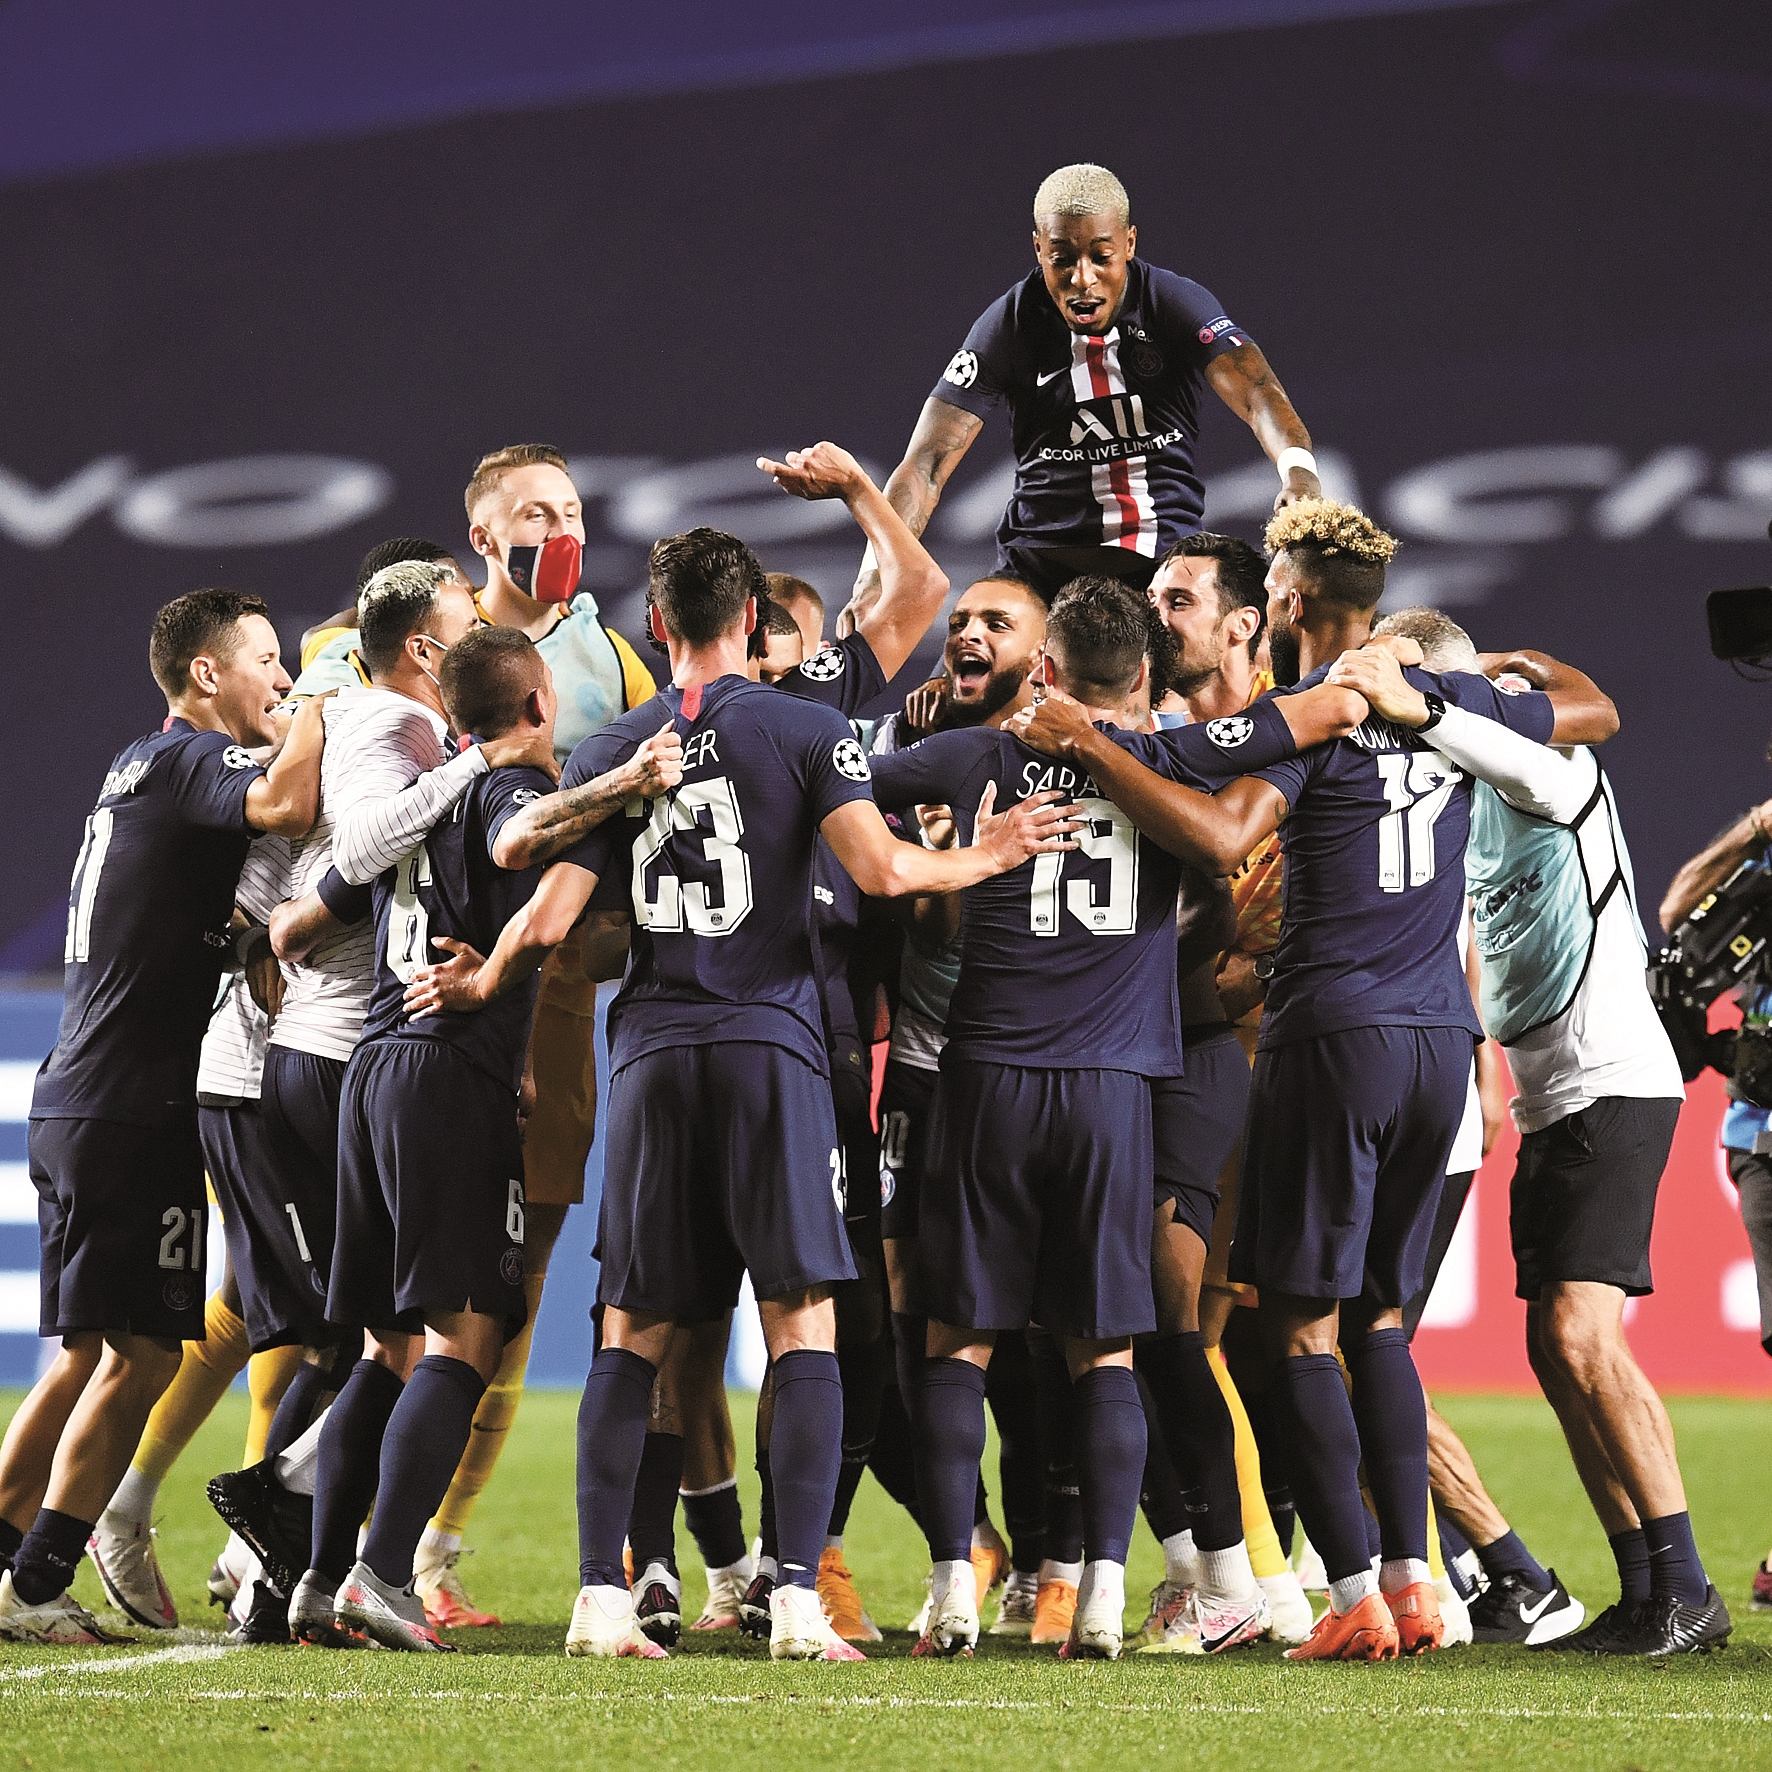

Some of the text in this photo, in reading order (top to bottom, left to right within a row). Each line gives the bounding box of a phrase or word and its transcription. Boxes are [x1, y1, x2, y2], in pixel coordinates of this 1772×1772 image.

[1087, 444, 1121, 460] LIVE
[1376, 751, 1464, 893] 17
[625, 775, 754, 938] 23
[1029, 797, 1140, 937] 19
[158, 1206, 202, 1272] 21
[284, 1202, 312, 1263] 1
[506, 1179, 525, 1244] 6
